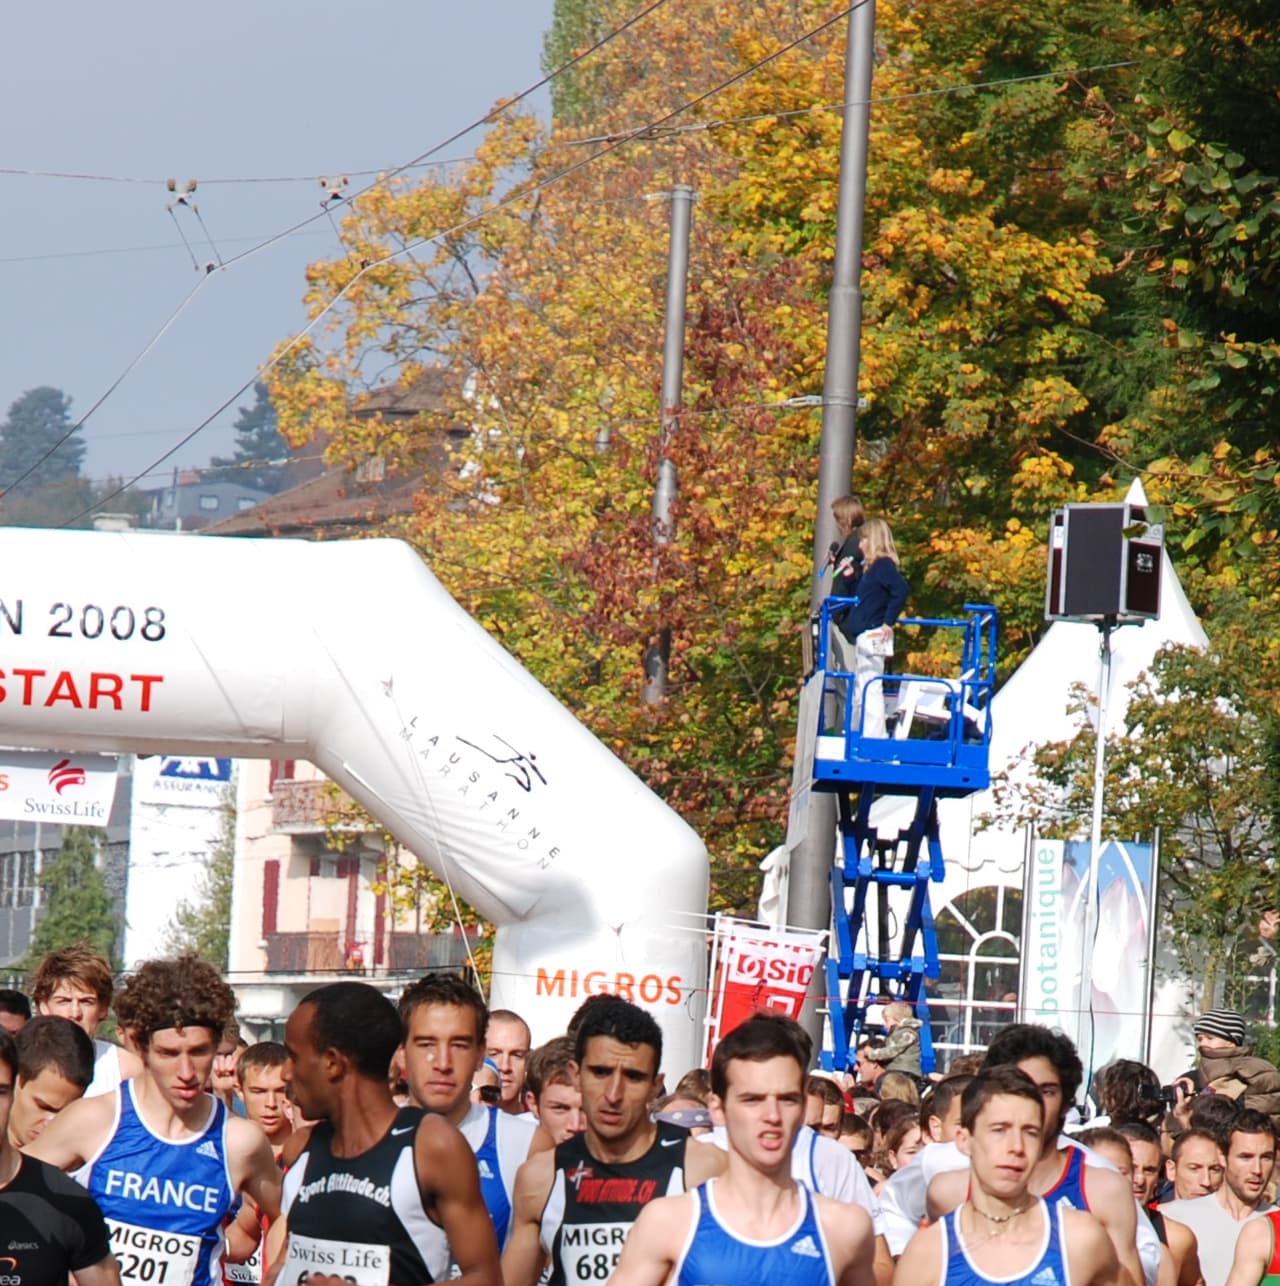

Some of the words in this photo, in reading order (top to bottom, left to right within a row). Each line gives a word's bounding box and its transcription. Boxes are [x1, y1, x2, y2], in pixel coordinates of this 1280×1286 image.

[48, 602, 167, 642] 2008
[409, 715, 561, 859] LAUSANNE
[24, 797, 106, 819] SwissLife
[1032, 846, 1061, 1017] botanique
[536, 967, 682, 1005] MIGROS
[105, 1169, 220, 1213] FRANCE
[290, 1241, 336, 1265] Swiss
[342, 1249, 382, 1269] Life
[563, 1227, 625, 1247] MIGR
